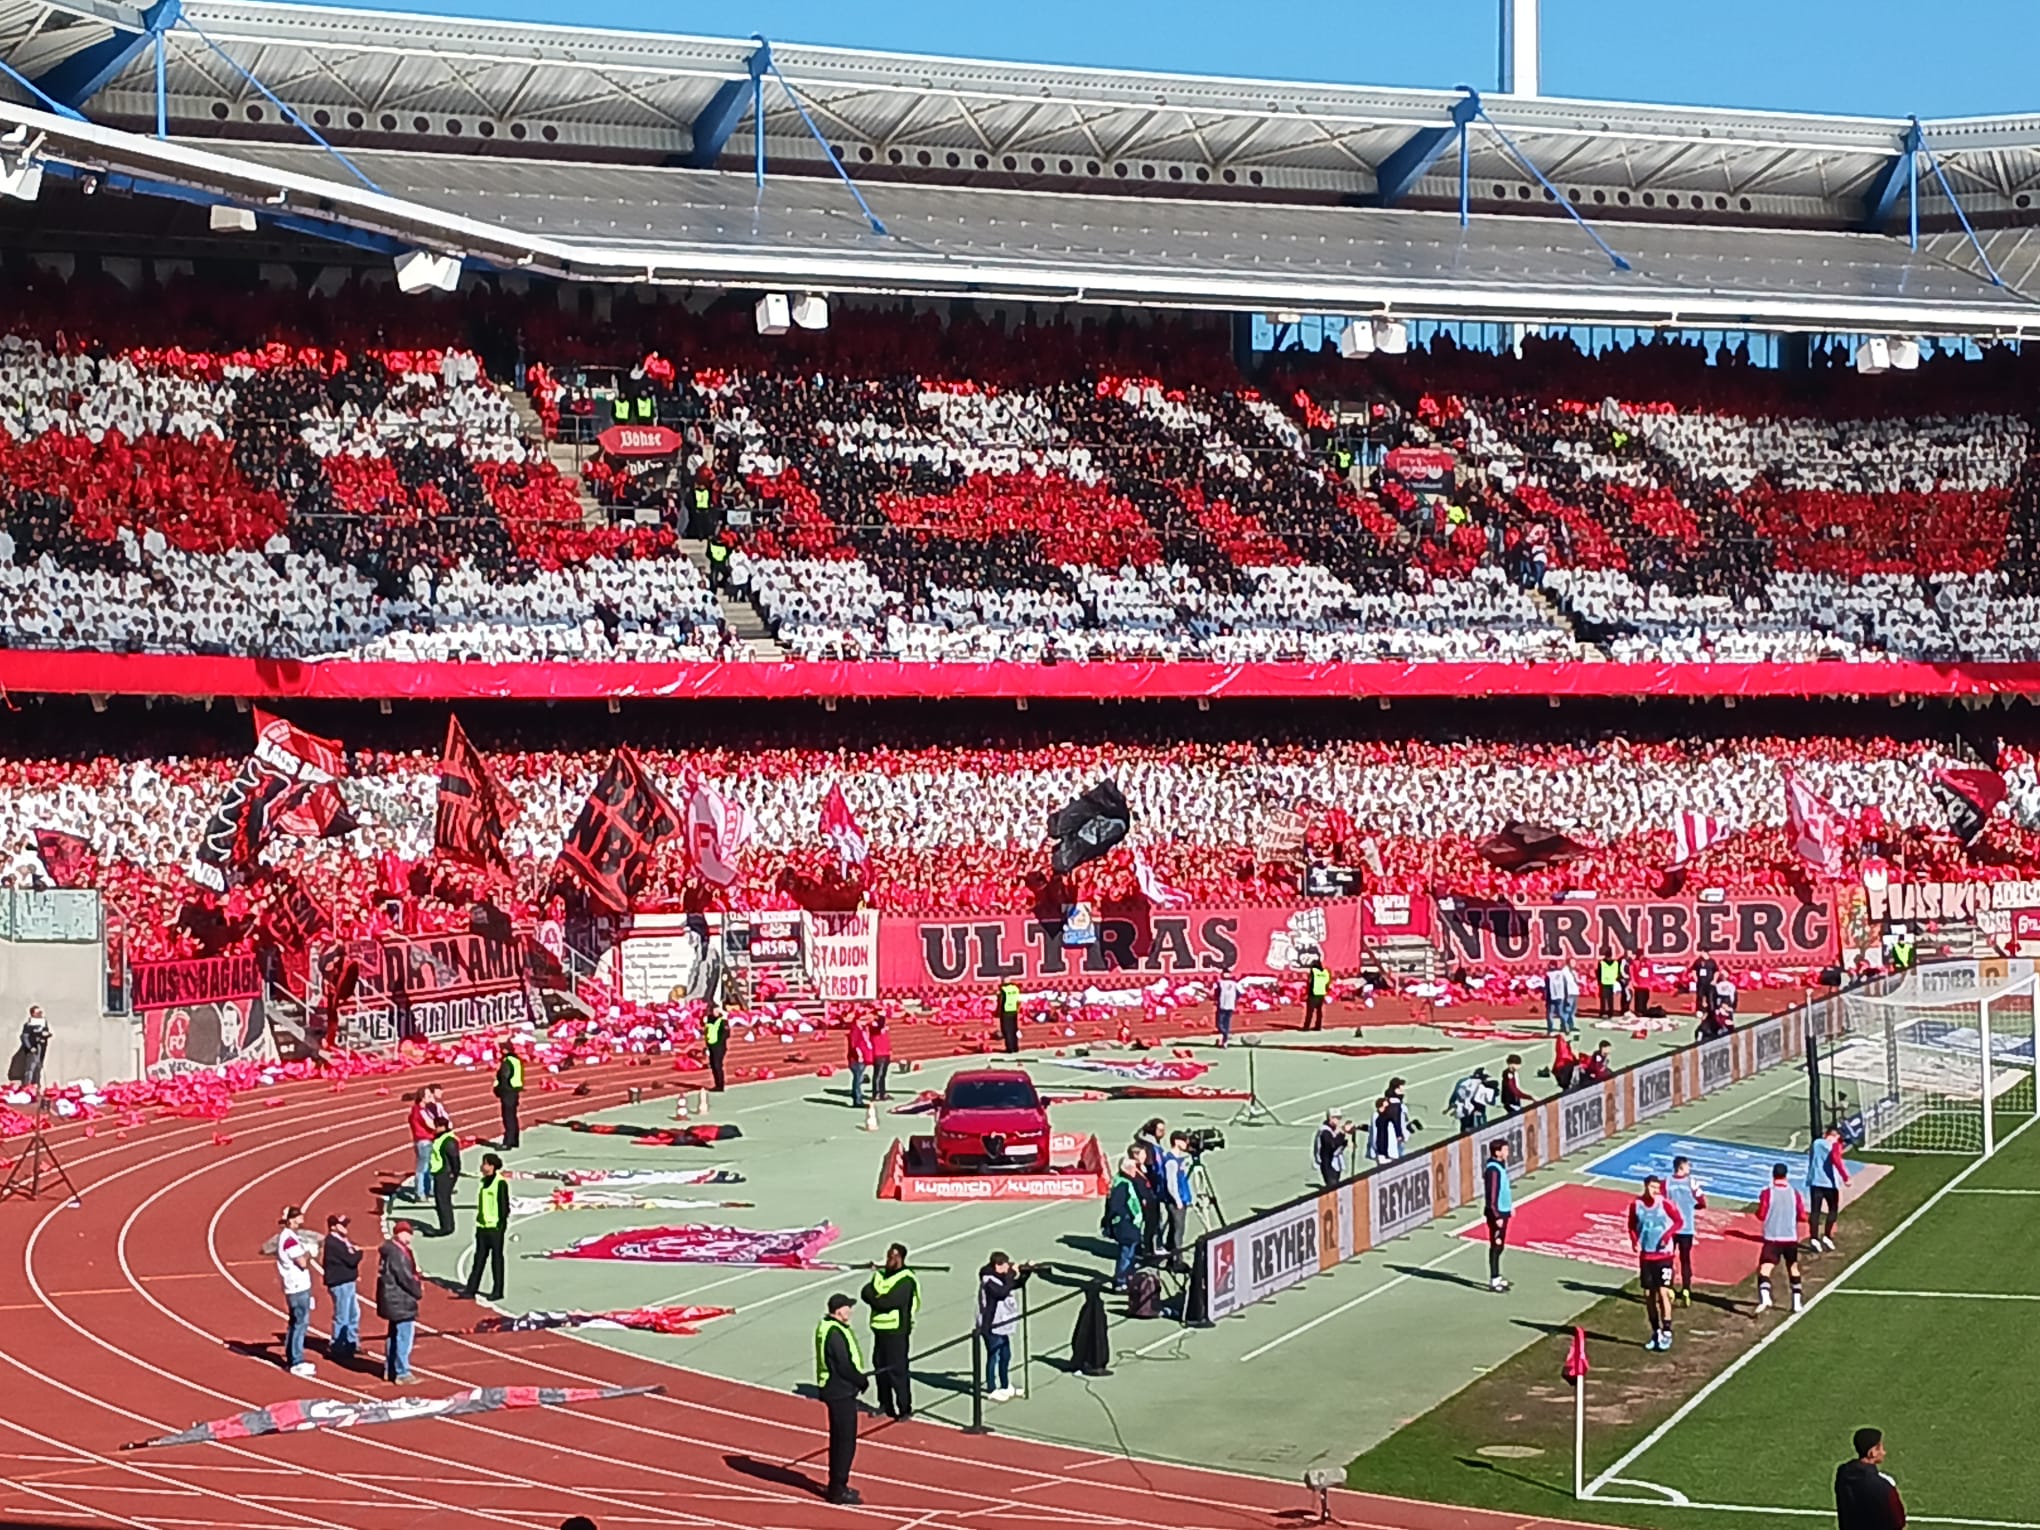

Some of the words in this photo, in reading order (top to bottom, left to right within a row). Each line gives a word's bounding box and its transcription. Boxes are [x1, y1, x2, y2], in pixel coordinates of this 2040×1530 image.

[813, 945, 869, 967] STADION
[921, 918, 1238, 981] ULTRAS
[1437, 893, 1828, 960] NÜRNBERG
[1564, 1096, 1603, 1140] REYHER
[1378, 1170, 1431, 1227] REYHER
[1252, 1217, 1317, 1284] REYHER
